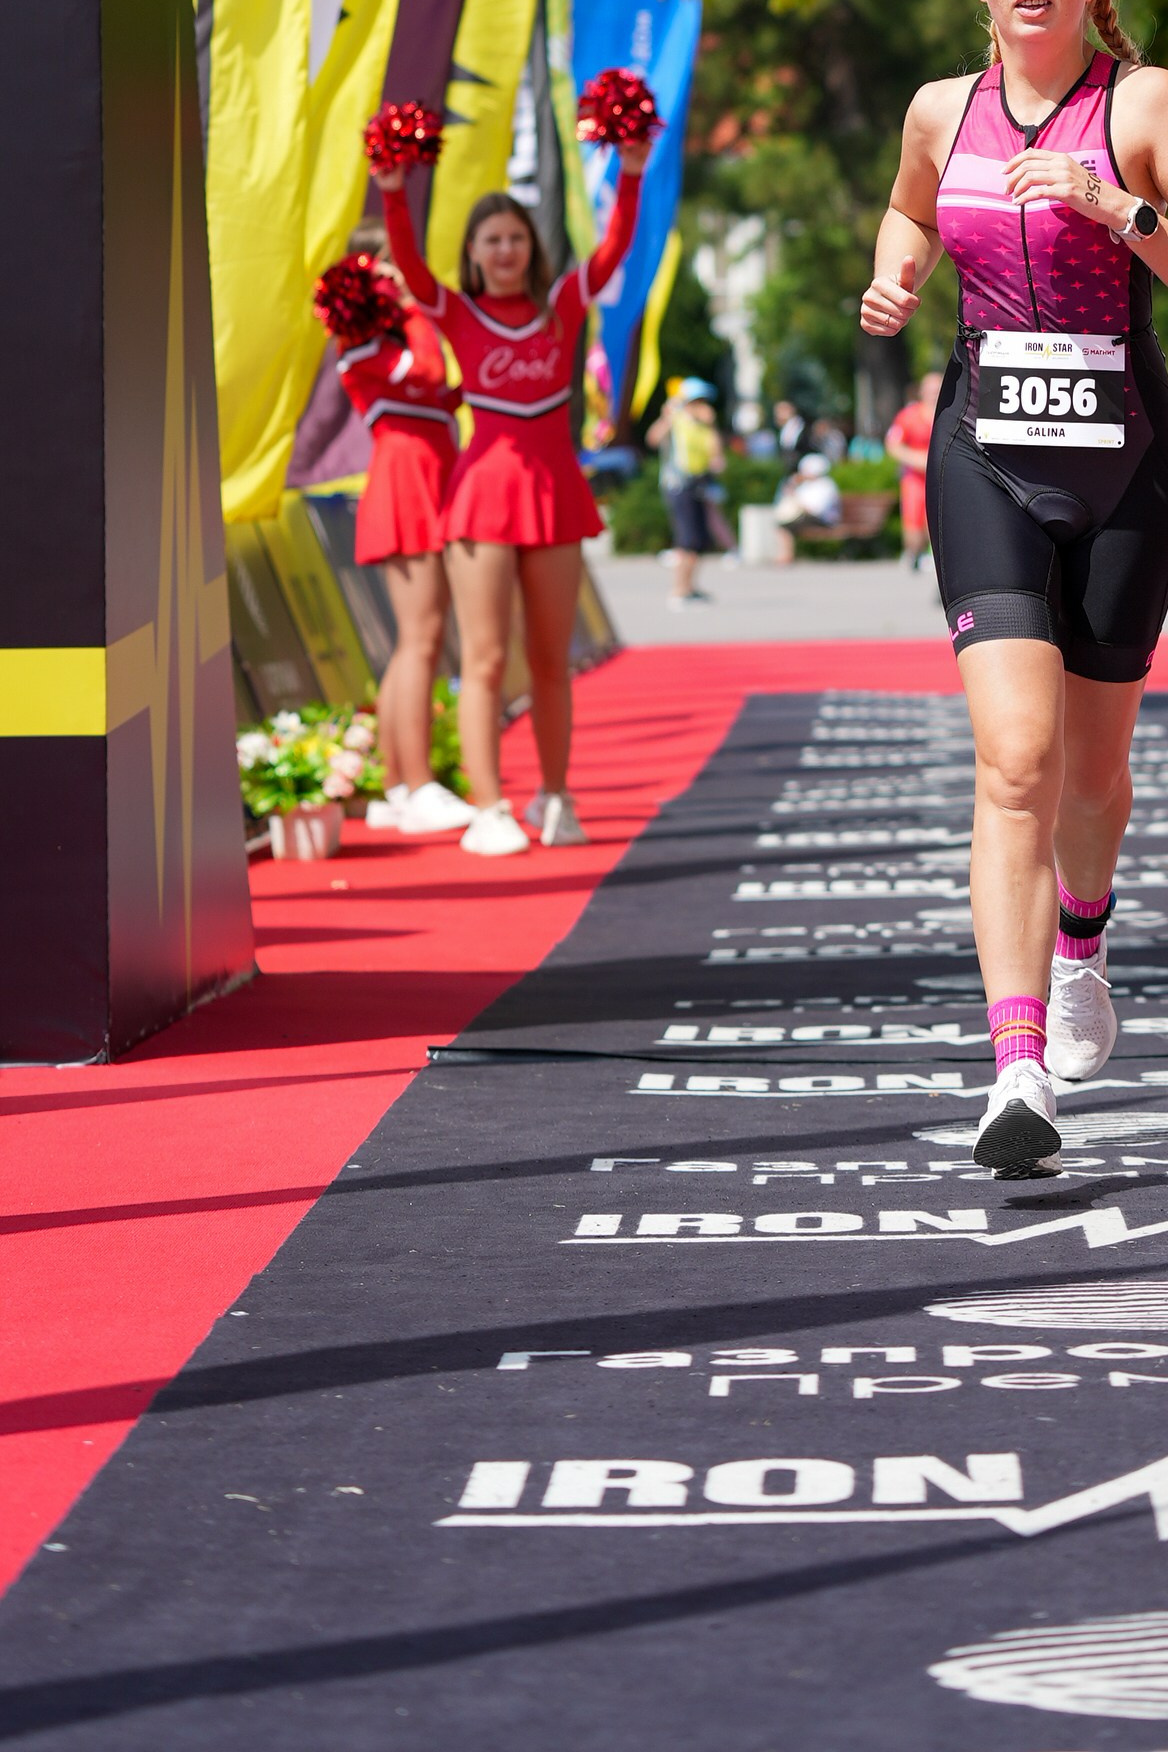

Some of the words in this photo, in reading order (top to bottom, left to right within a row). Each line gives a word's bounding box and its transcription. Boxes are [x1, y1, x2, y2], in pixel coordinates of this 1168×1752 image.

[1024, 342, 1044, 352] IRON
[1052, 343, 1073, 353] STAR
[478, 345, 561, 389] Cool
[999, 375, 1098, 417] 3056
[1026, 426, 1066, 438] GALINA
[661, 1023, 962, 1042] IRON
[636, 1072, 964, 1093] IRON
[574, 1208, 989, 1237] IRON
[457, 1452, 1025, 1508] IRON
